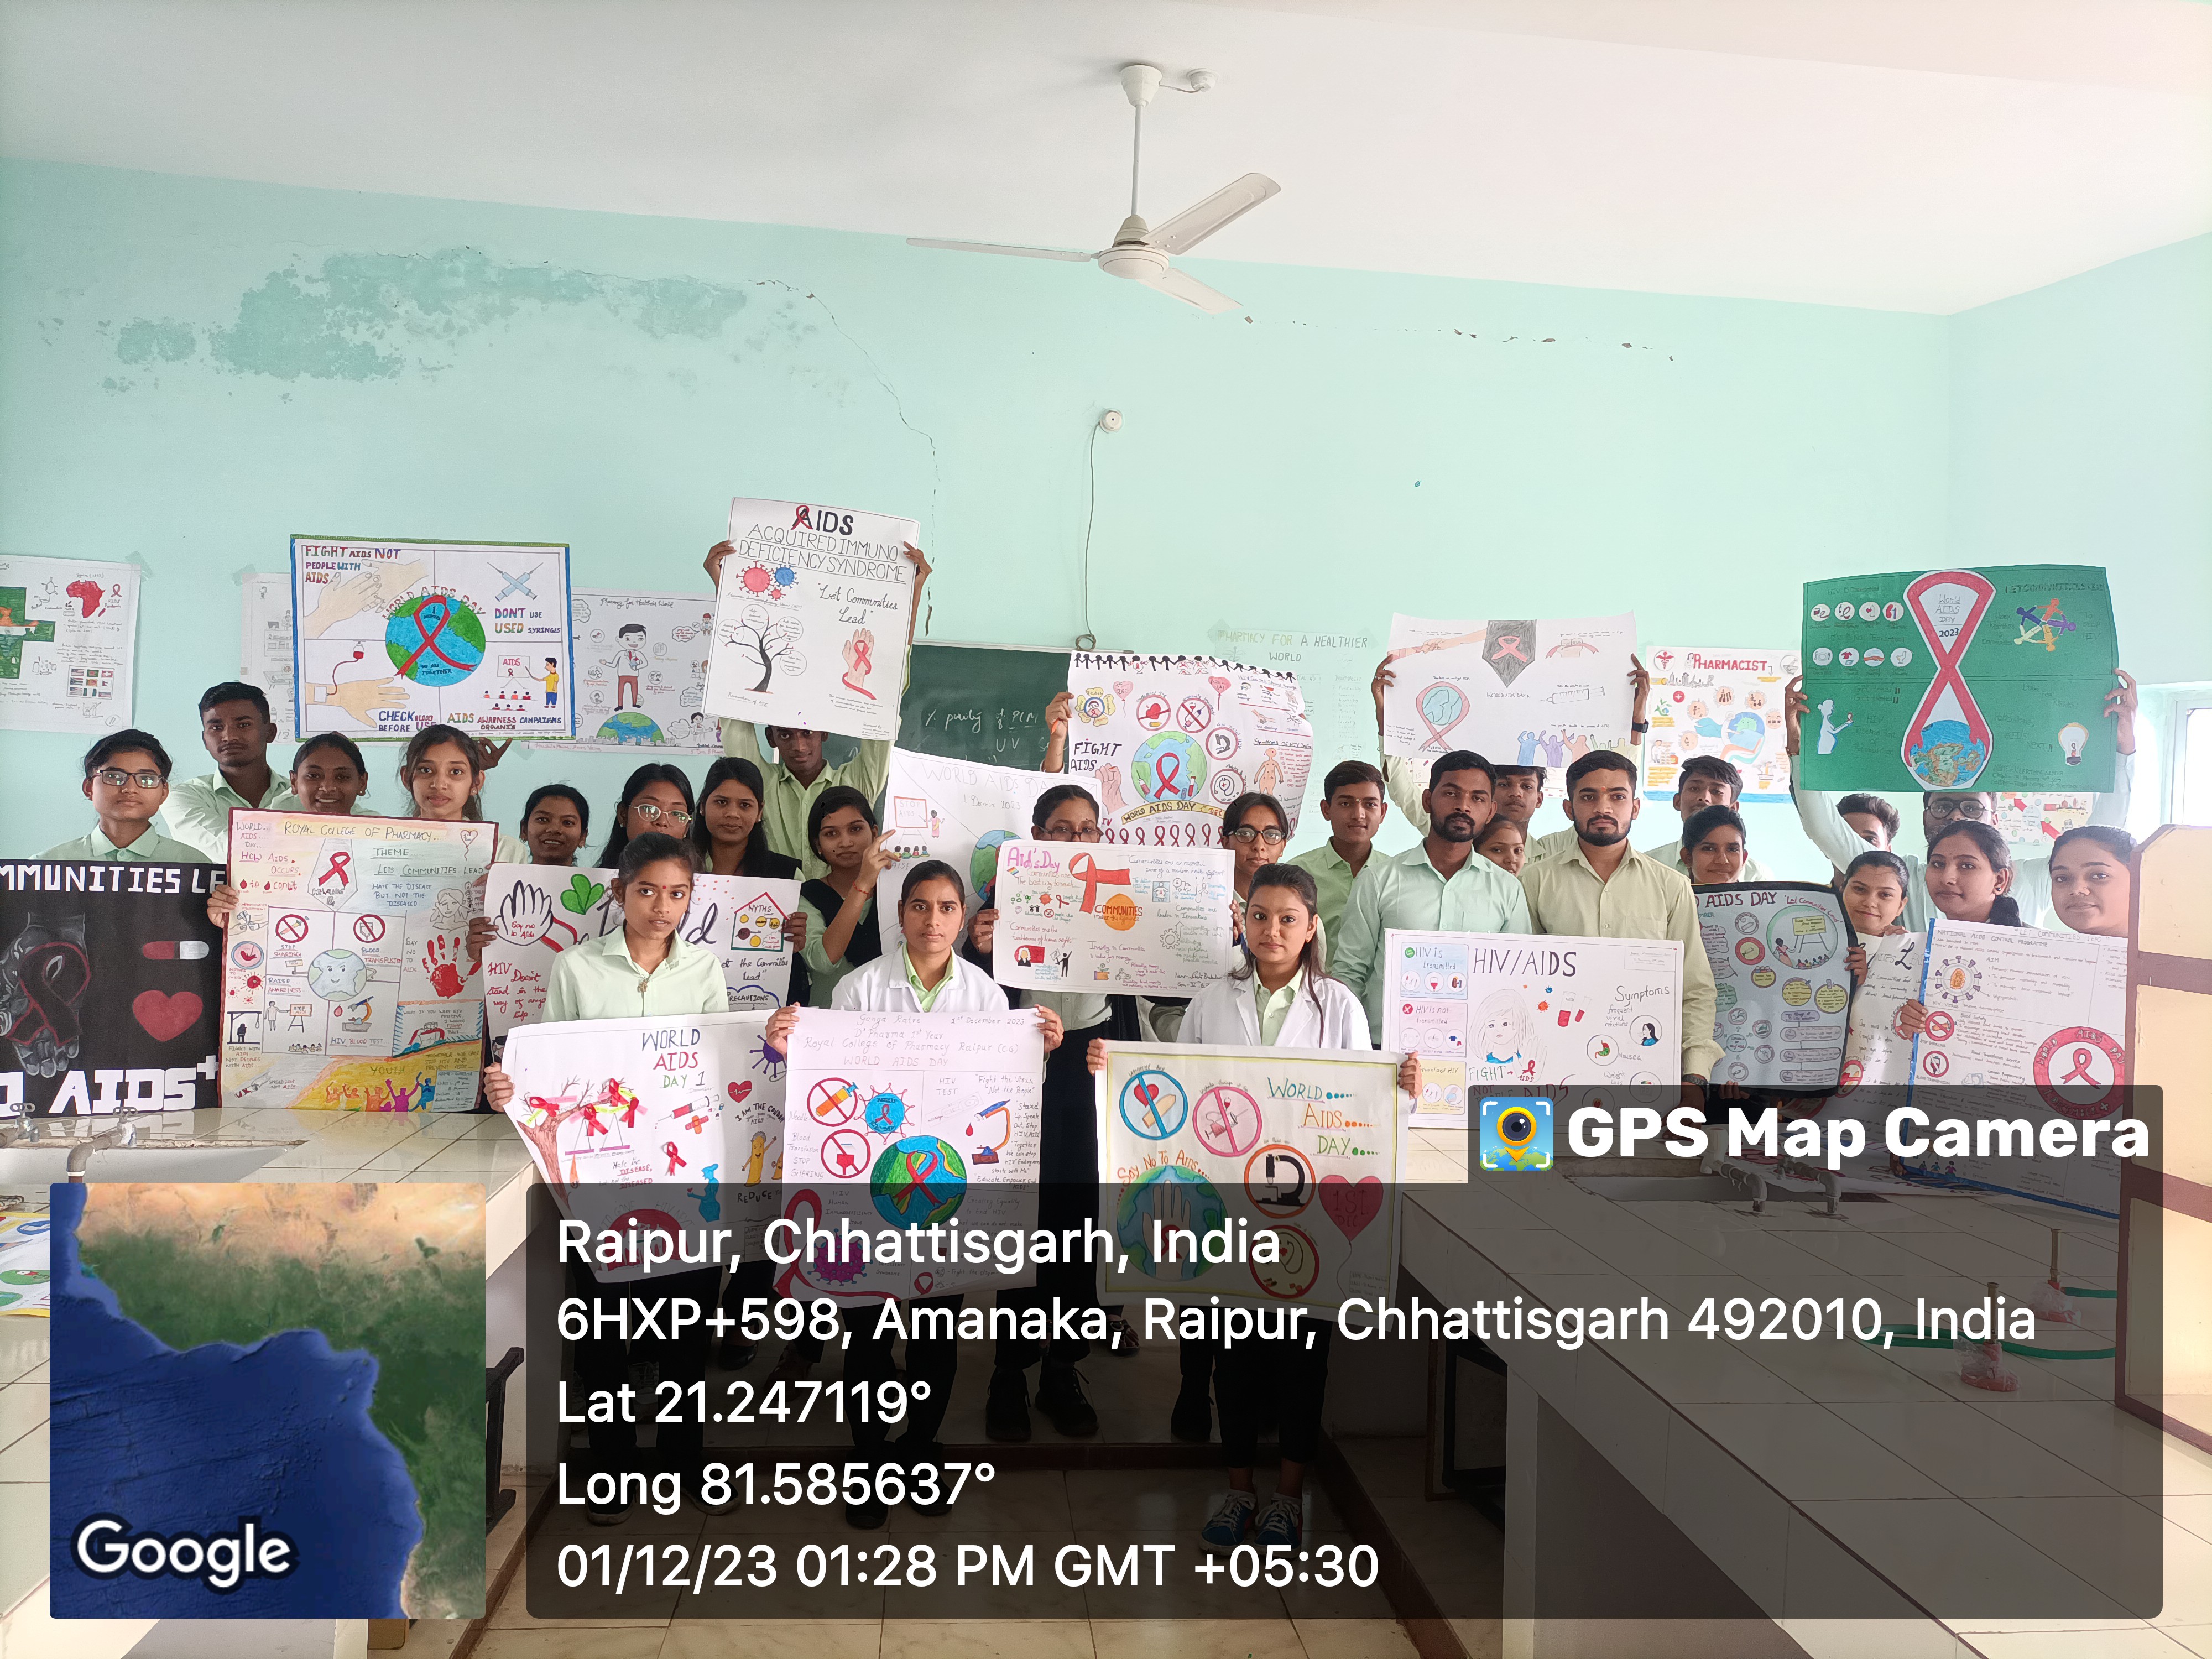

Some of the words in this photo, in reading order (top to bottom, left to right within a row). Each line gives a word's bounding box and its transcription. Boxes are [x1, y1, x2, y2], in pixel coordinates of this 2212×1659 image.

[791, 505, 854, 536] AIDS
[748, 524, 836, 552] ACQUIRED
[838, 539, 898, 561] IMMUNO
[305, 546, 348, 559] FIGHT
[375, 549, 401, 559] NOT
[306, 561, 336, 570] PEOPLE
[739, 540, 827, 570] DEFICIENCY
[826, 556, 907, 582] SYNDROME
[306, 573, 330, 583] AIDS
[382, 589, 415, 621] WORLD
[421, 585, 457, 598] AIDS
[460, 594, 486, 616] DAY
[1938, 594, 1960, 604] World
[494, 623, 524, 633] USED
[1939, 628, 1959, 638] 2023
[1217, 630, 1265, 643] PHARMACY
[1272, 634, 1293, 645] FOR
[1301, 635, 1308, 646] A
[1313, 635, 1368, 648] HEALTHIER
[1269, 652, 1302, 662] WORLD
[1694, 653, 1767, 671] PHARMACIST
[378, 711, 414, 722] CHECK
[447, 713, 474, 723] AIDS
[1073, 738, 1123, 757] FIGHT
[1070, 759, 1097, 771] AIDS
[921, 761, 978, 786] WORLD
[1001, 800, 1021, 810] 2023
[1124, 807, 1146, 823] WORLD
[1149, 802, 1173, 815] AIDS
[1177, 802, 1196, 812] DAY
[285, 822, 315, 834] ROYAL
[320, 825, 356, 836] COLLEGE
[364, 828, 380, 836] OF
[241, 851, 262, 861] HOW
[268, 854, 289, 863] AIDS
[1043, 851, 1060, 872] Day
[402, 865, 457, 875] COMMUNITIES
[1705, 894, 1744, 908] AIDS
[1751, 892, 1777, 906] DAY
[748, 904, 771, 912] MYTHS
[1094, 904, 1142, 916] COMMUNITIES
[1937, 930, 1966, 938] NATIONAL
[2037, 930, 2081, 941] COMMUNITIES
[406, 937, 418, 946] SAY
[1415, 946, 1431, 958] HIV
[1433, 947, 1443, 958] is
[1473, 948, 1577, 977] HIV/AIDS
[487, 962, 513, 976] HIV
[1614, 985, 1670, 1007] Symptoms
[1415, 1005, 1428, 1014] HIV
[857, 1014, 886, 1026] Ganga
[965, 1017, 1003, 1025] December
[643, 1029, 700, 1051] WORLD
[803, 1038, 834, 1050] Royal
[842, 1038, 878, 1055] College
[886, 1039, 898, 1050] of
[905, 1041, 950, 1056] Pharmacy
[653, 1052, 698, 1071] AIDS
[843, 1056, 880, 1066] WORLD
[892, 1057, 919, 1067] AIDS
[929, 1058, 949, 1067] DAY
[371, 1066, 405, 1074] YOUTH
[1469, 1066, 1506, 1082] FIGHT
[664, 1074, 687, 1088] DAY
[695, 1071, 705, 1086] 1
[1001, 1075, 1012, 1083] the
[1518, 1074, 1535, 1083] AIDS
[792, 1132, 810, 1141] Blood
[1143, 1154, 1156, 1170] NO
[1158, 1150, 1168, 1165] TO
[791, 1169, 824, 1178] SHARING
[737, 1190, 772, 1203] REDUCE
